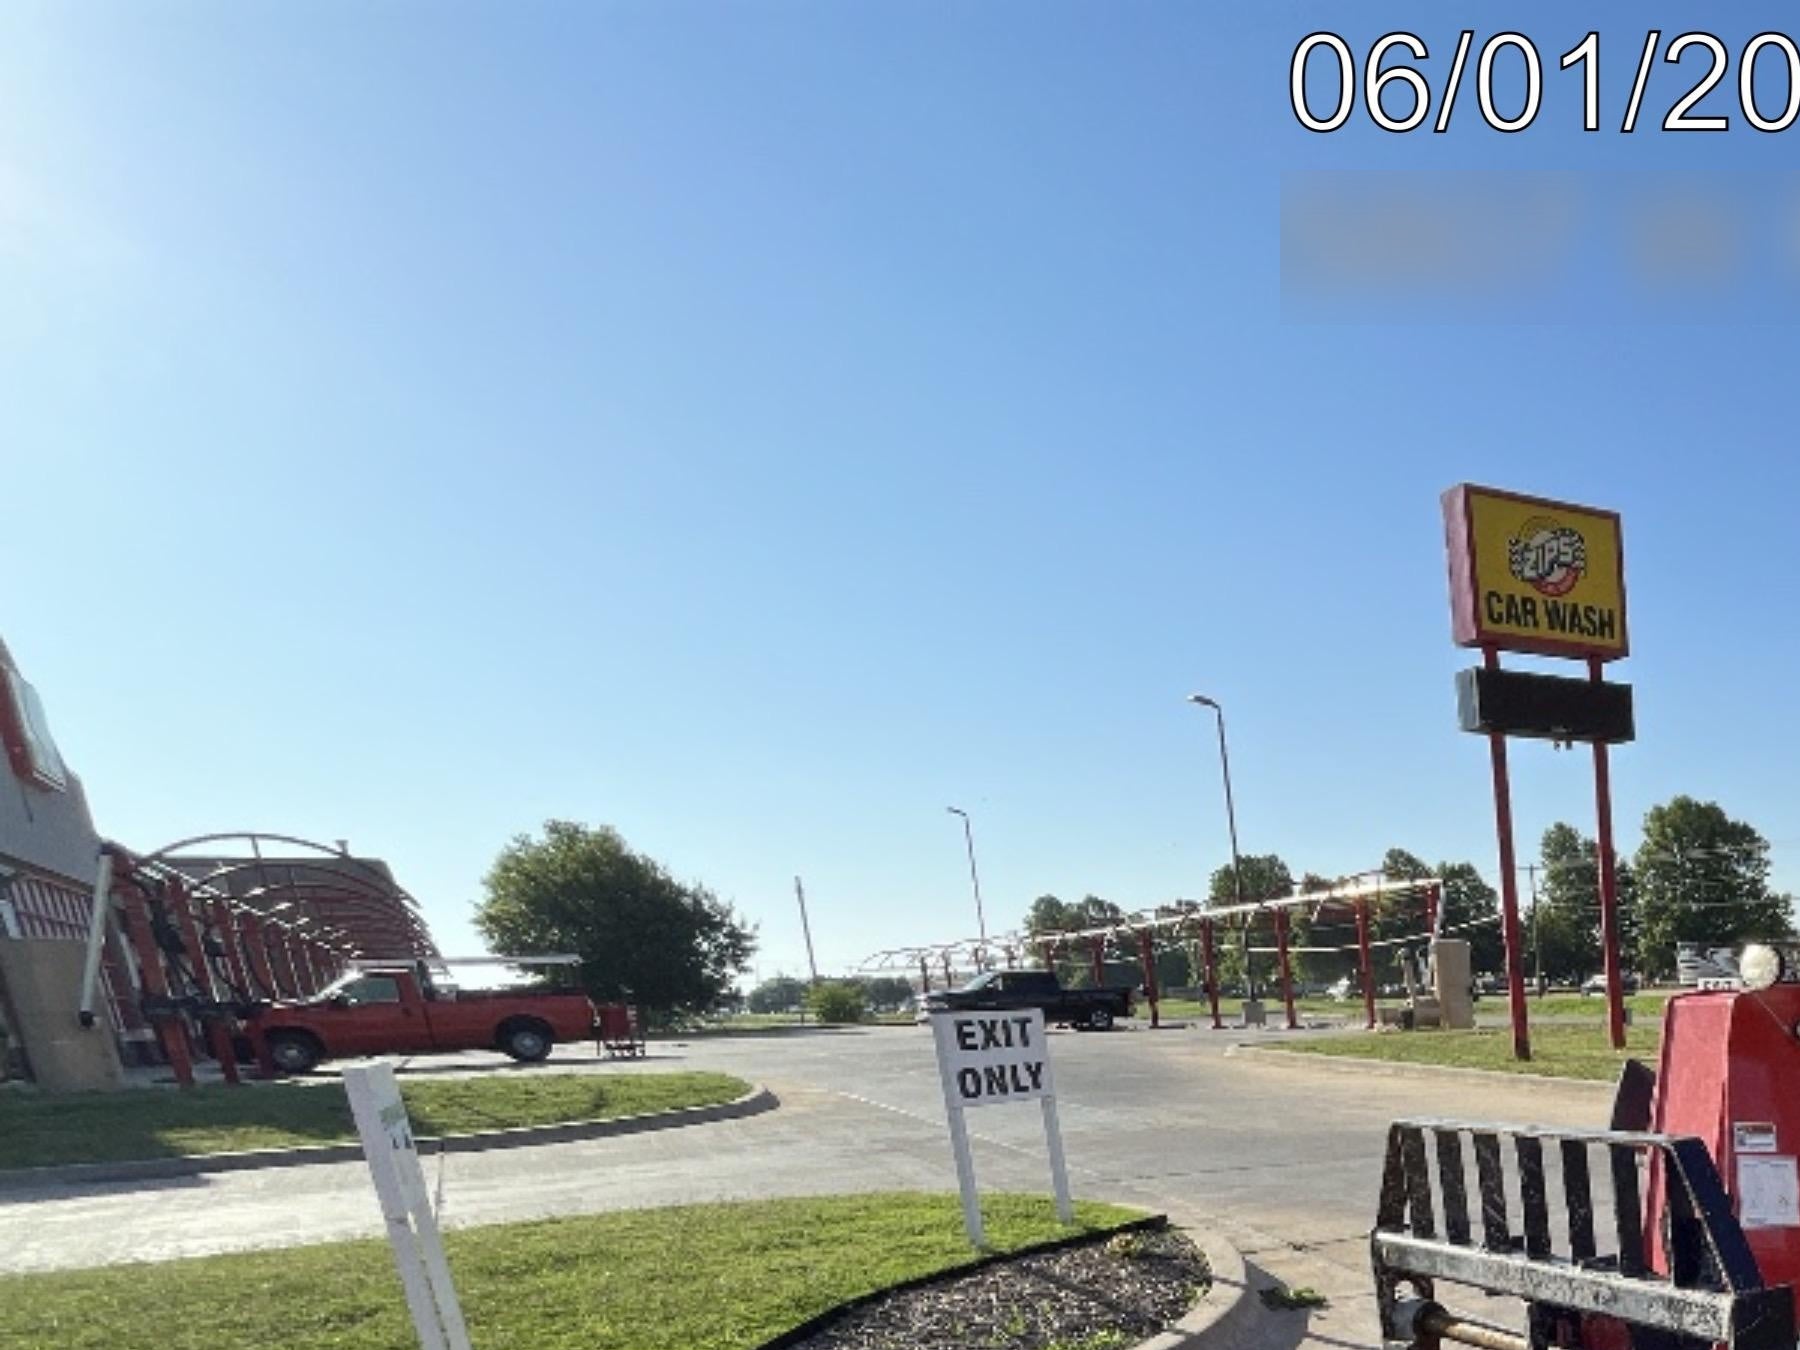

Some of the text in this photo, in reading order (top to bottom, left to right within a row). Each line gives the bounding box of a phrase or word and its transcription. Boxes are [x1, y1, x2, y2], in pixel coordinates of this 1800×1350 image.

[1522, 534, 1575, 580] ZIPS
[1486, 592, 1615, 640] CAR WASH
[954, 1016, 1032, 1051] EXIT
[957, 1061, 1043, 1099] ONLY
